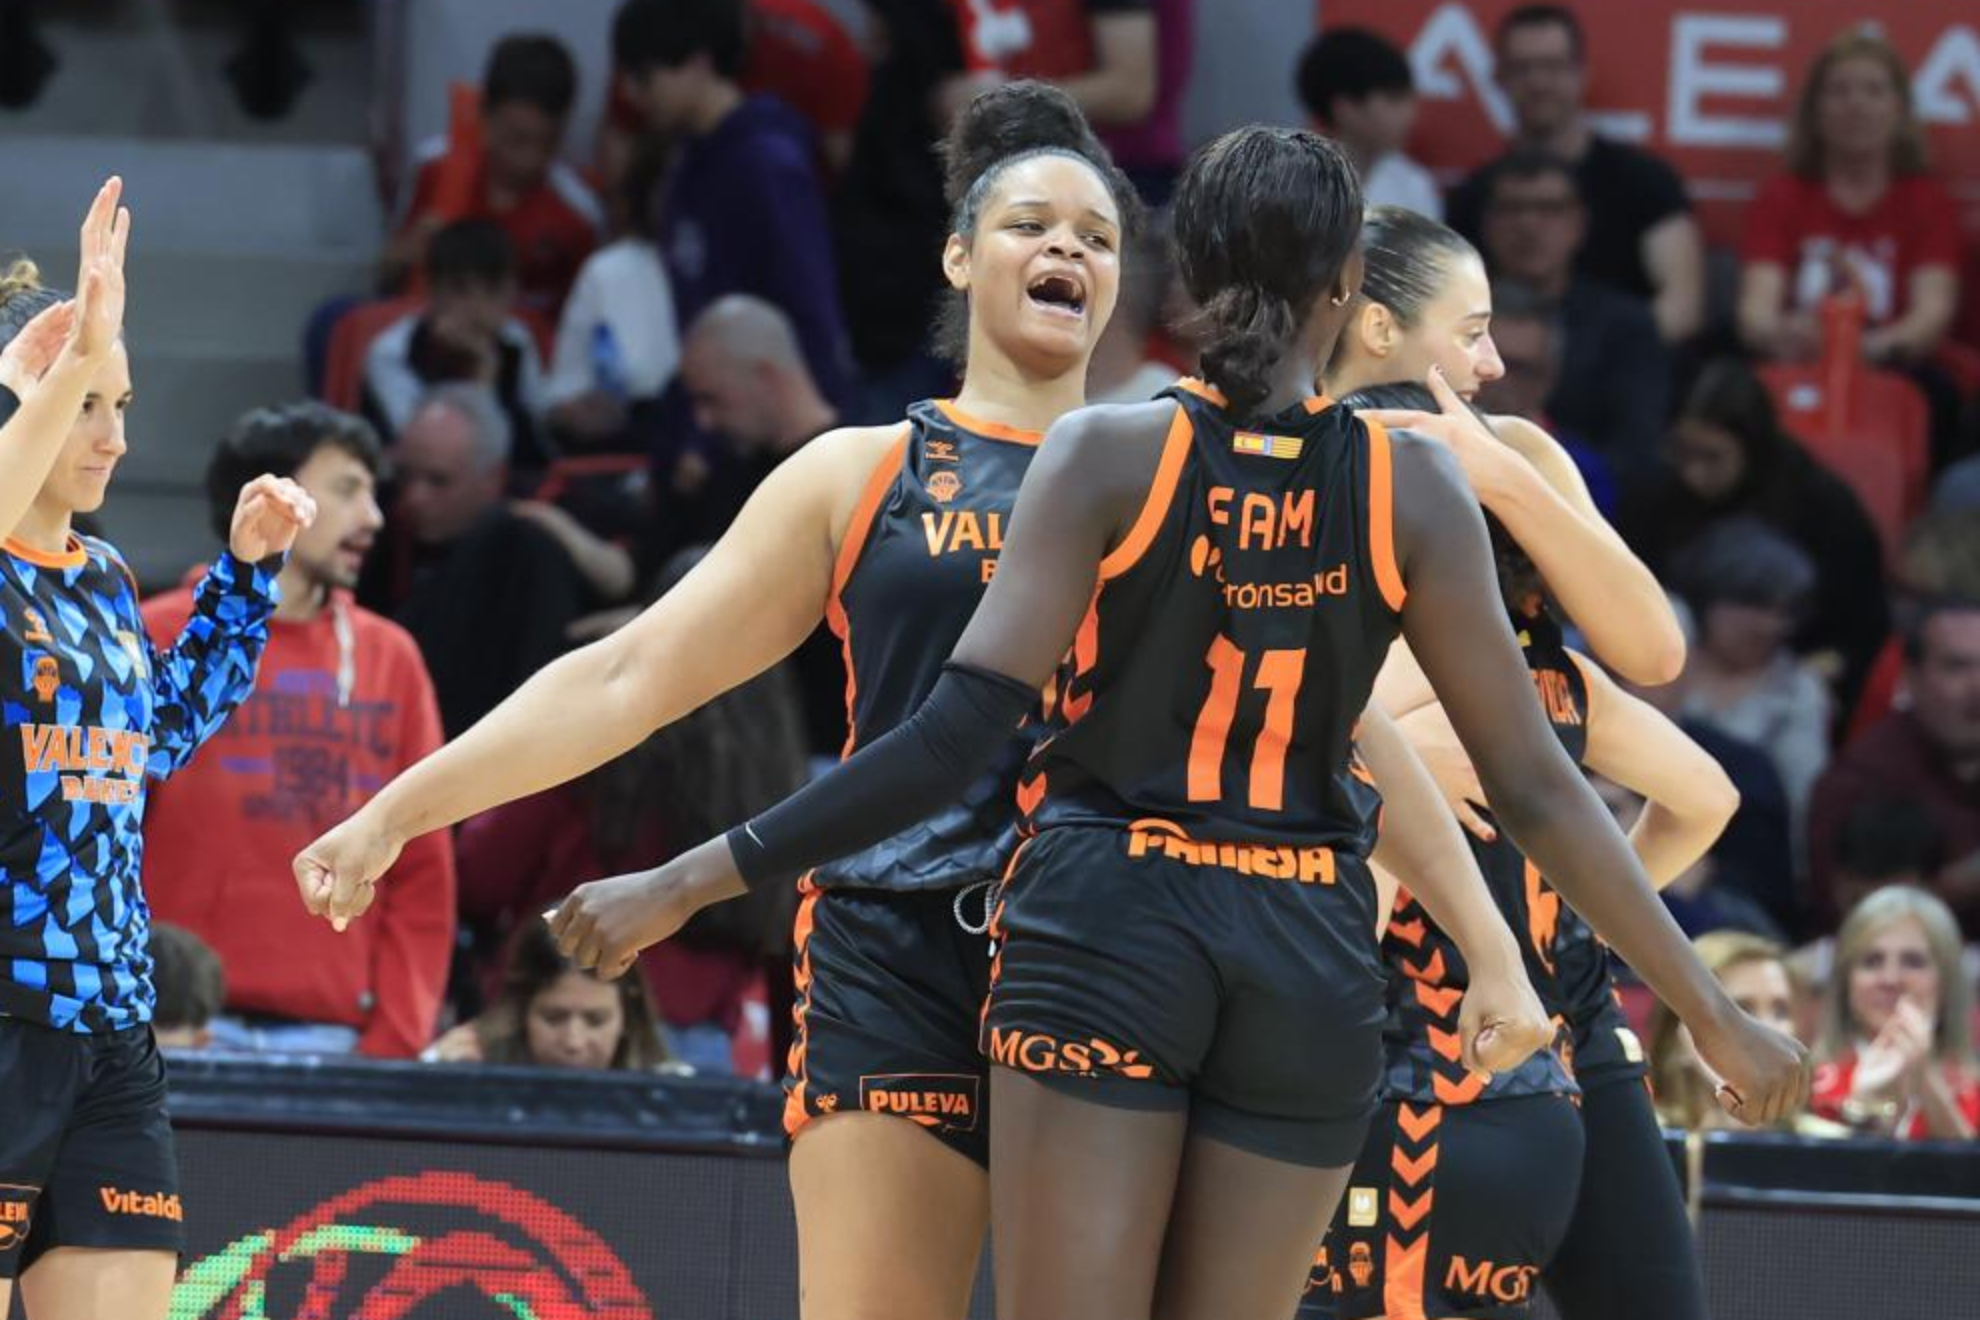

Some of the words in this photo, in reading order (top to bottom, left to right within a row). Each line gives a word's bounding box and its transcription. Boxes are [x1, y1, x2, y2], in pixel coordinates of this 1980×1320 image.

[1207, 485, 1316, 551] FAM
[1187, 632, 1307, 812] 11
[990, 1027, 1091, 1072] MGS
[869, 1090, 970, 1115] PULEVA
